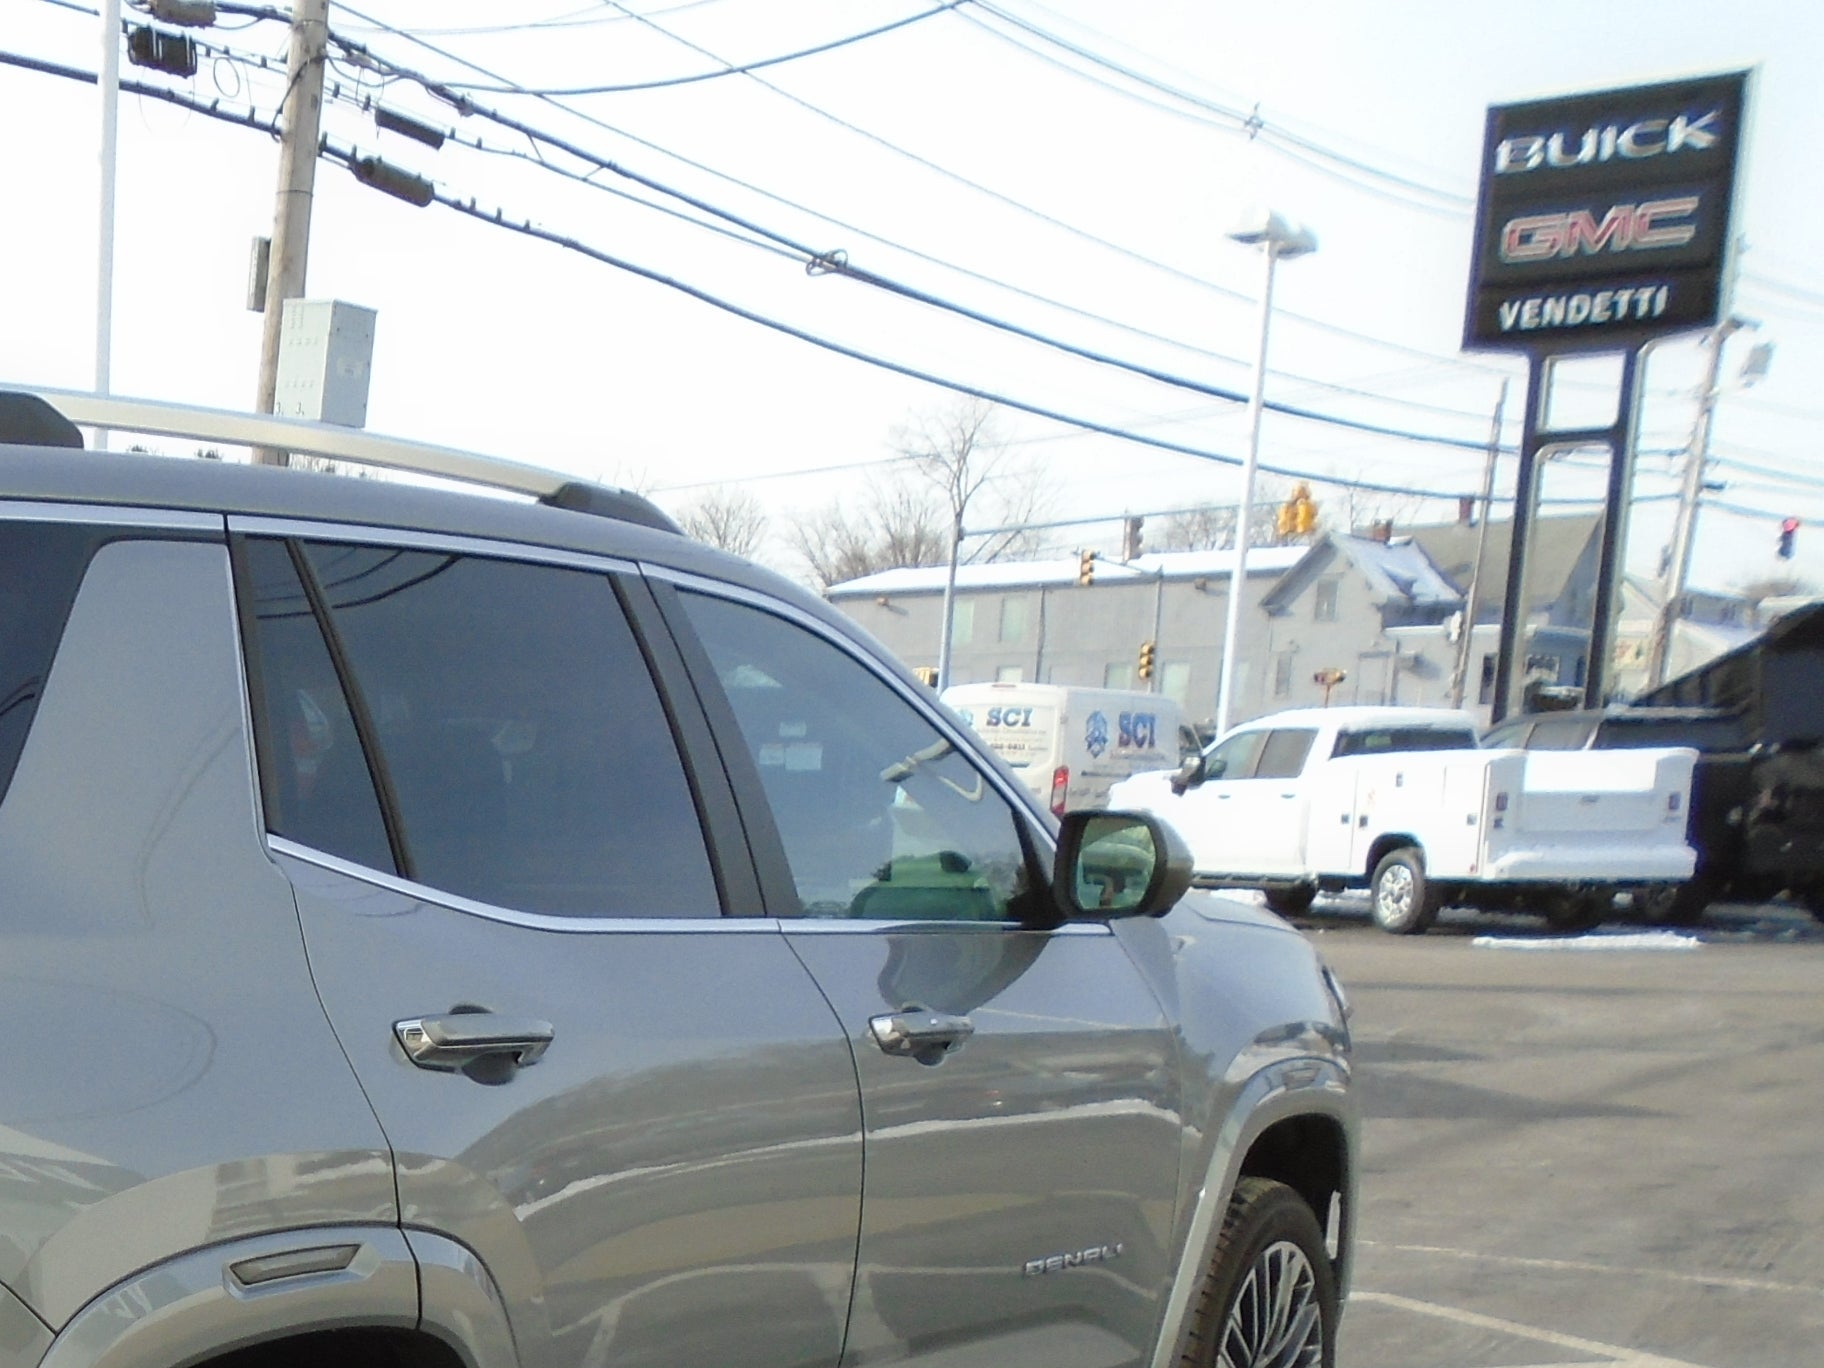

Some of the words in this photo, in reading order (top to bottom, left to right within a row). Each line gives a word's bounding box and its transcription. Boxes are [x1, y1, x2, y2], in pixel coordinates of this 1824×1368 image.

[1494, 109, 1722, 174] BUICK
[1500, 196, 1700, 264] GMC
[1498, 284, 1670, 332] VENDETTI
[986, 706, 1033, 728] SCI
[1118, 710, 1157, 749] SCI
[1024, 1243, 1124, 1277] DENALI
